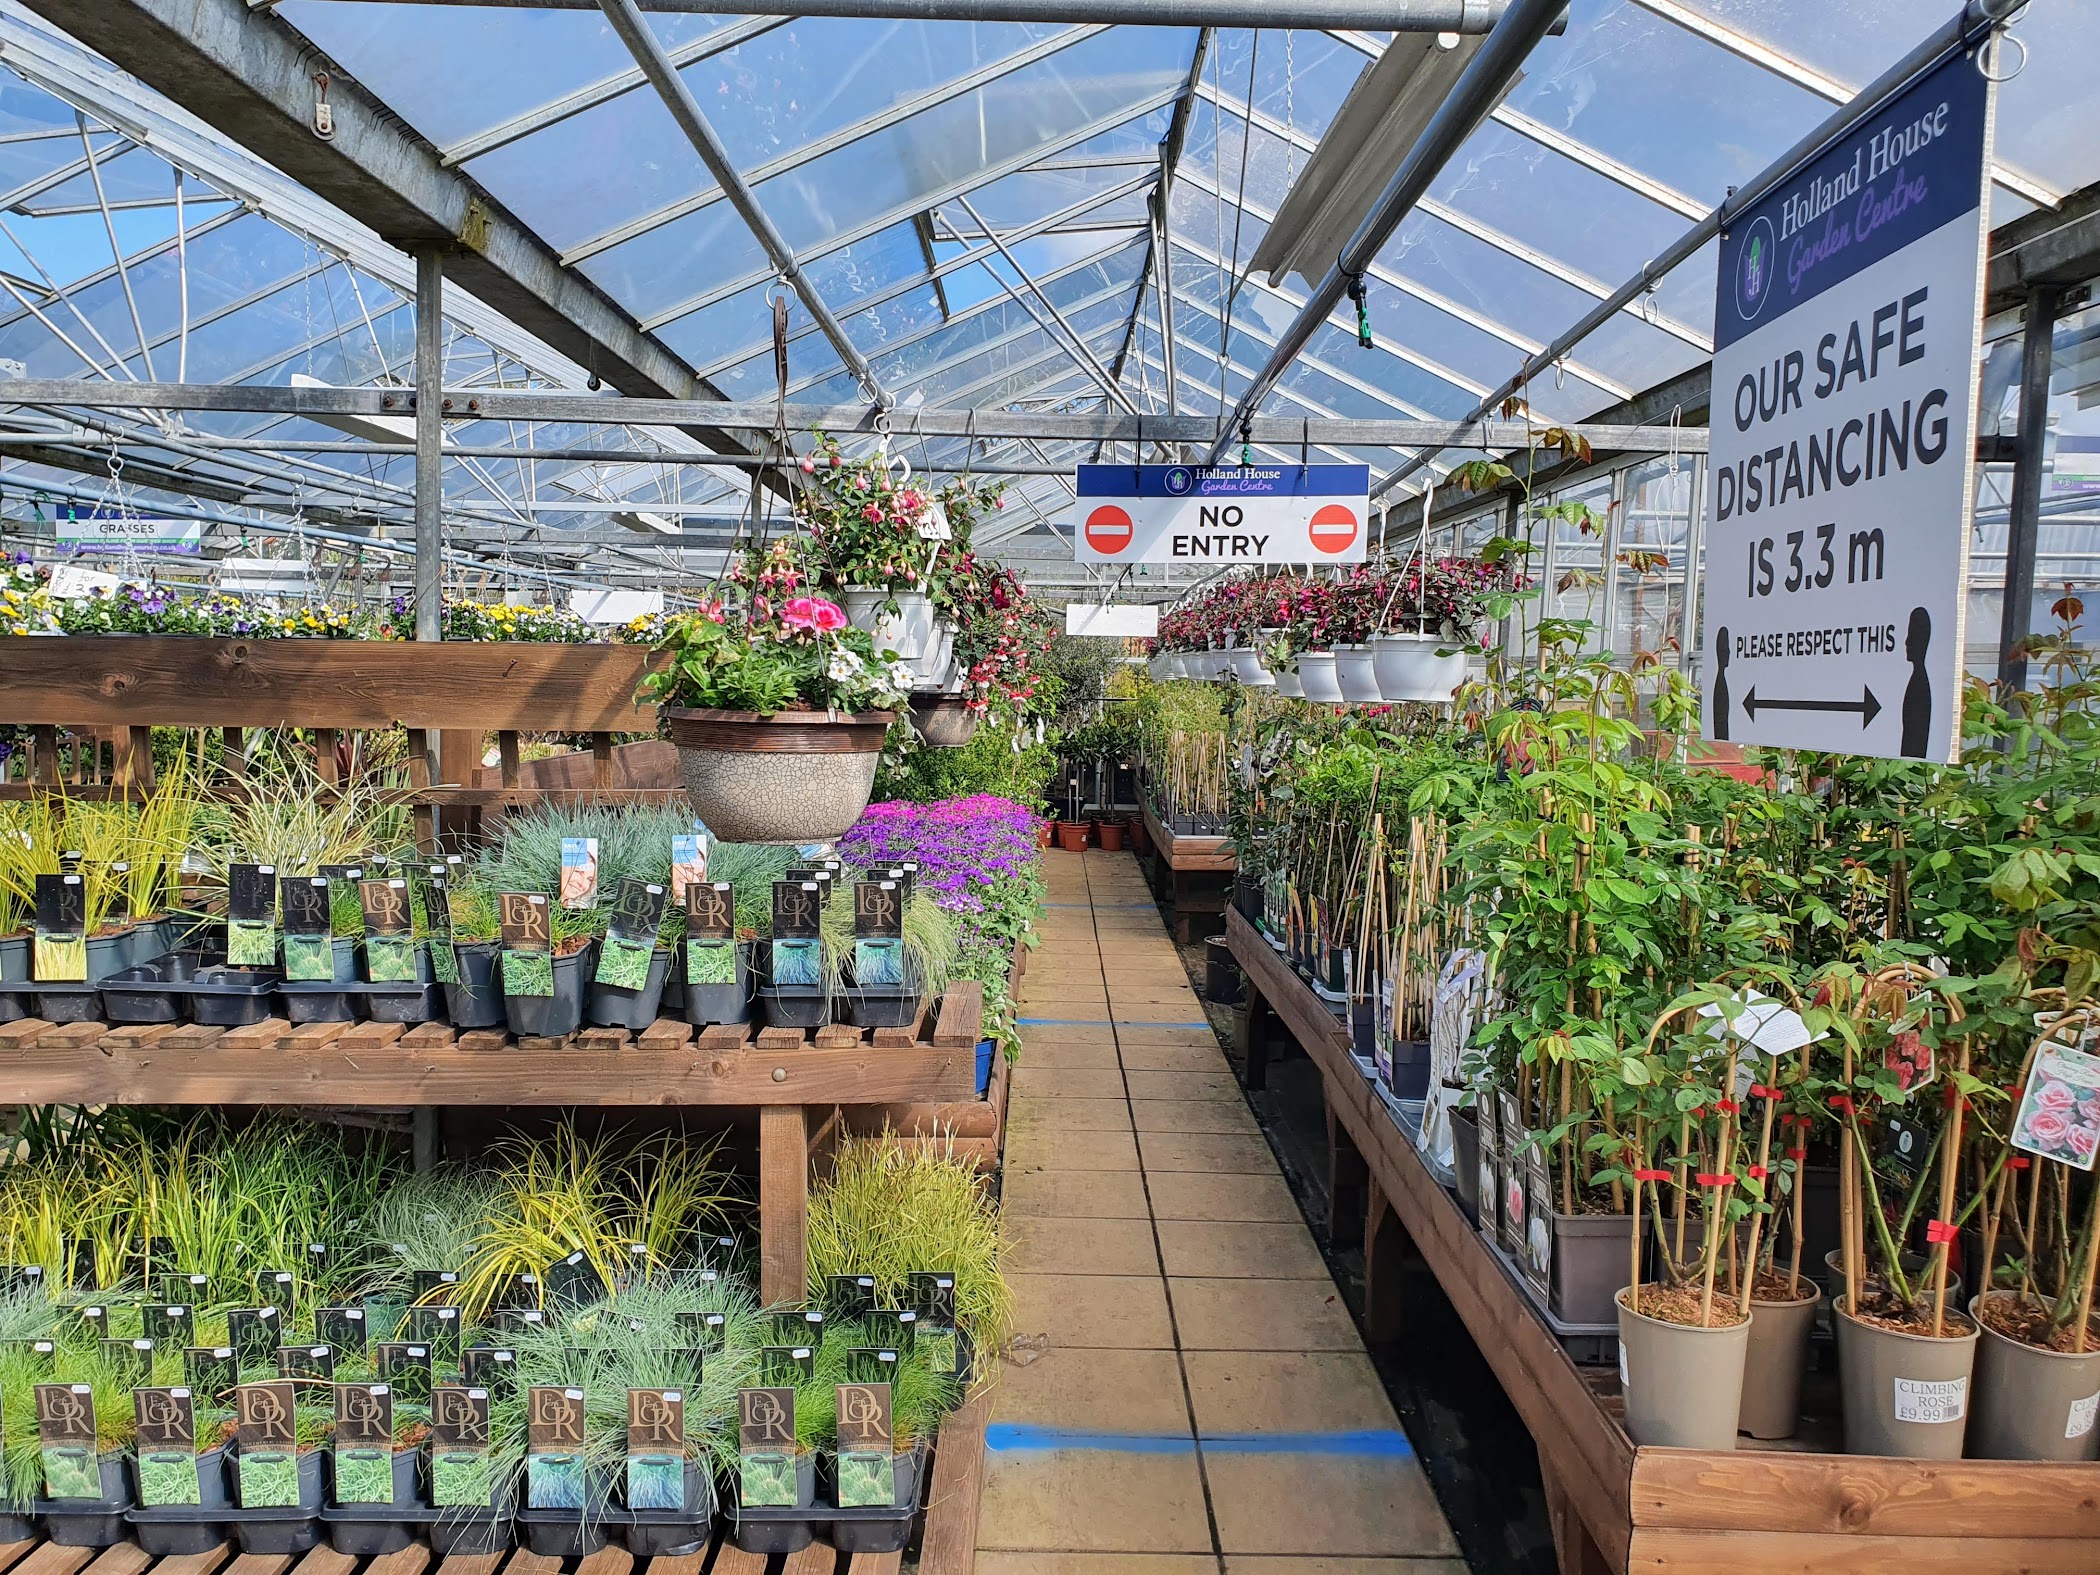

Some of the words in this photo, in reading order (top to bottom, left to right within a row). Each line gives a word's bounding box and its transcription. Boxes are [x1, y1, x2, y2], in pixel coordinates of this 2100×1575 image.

[1779, 151, 1861, 241] Holland
[1866, 102, 1949, 183] House
[1787, 212, 1851, 294] Garden
[1855, 168, 1928, 244] Centre
[1735, 349, 1804, 432] OUR
[1815, 286, 1928, 400] SAFE
[1716, 388, 1949, 522] DISTANCING
[1195, 468, 1241, 479] Holland
[1244, 468, 1281, 479] House
[1201, 480, 1238, 495] Garden
[1239, 479, 1274, 492] Centre
[1199, 505, 1244, 528] NO
[1172, 535, 1270, 557] ENTRY
[1748, 537, 1775, 598] IS
[1784, 522, 1836, 593] 3.3
[1848, 527, 1885, 584] m
[1735, 633, 1783, 659] PLEASE
[1786, 628, 1853, 656] RESPECT
[1857, 624, 1896, 653] THIS
[1899, 1379, 1965, 1395] CLIMBING
[1918, 1396, 1954, 1408] ROSE
[1900, 1407, 1941, 1421] £9.99
